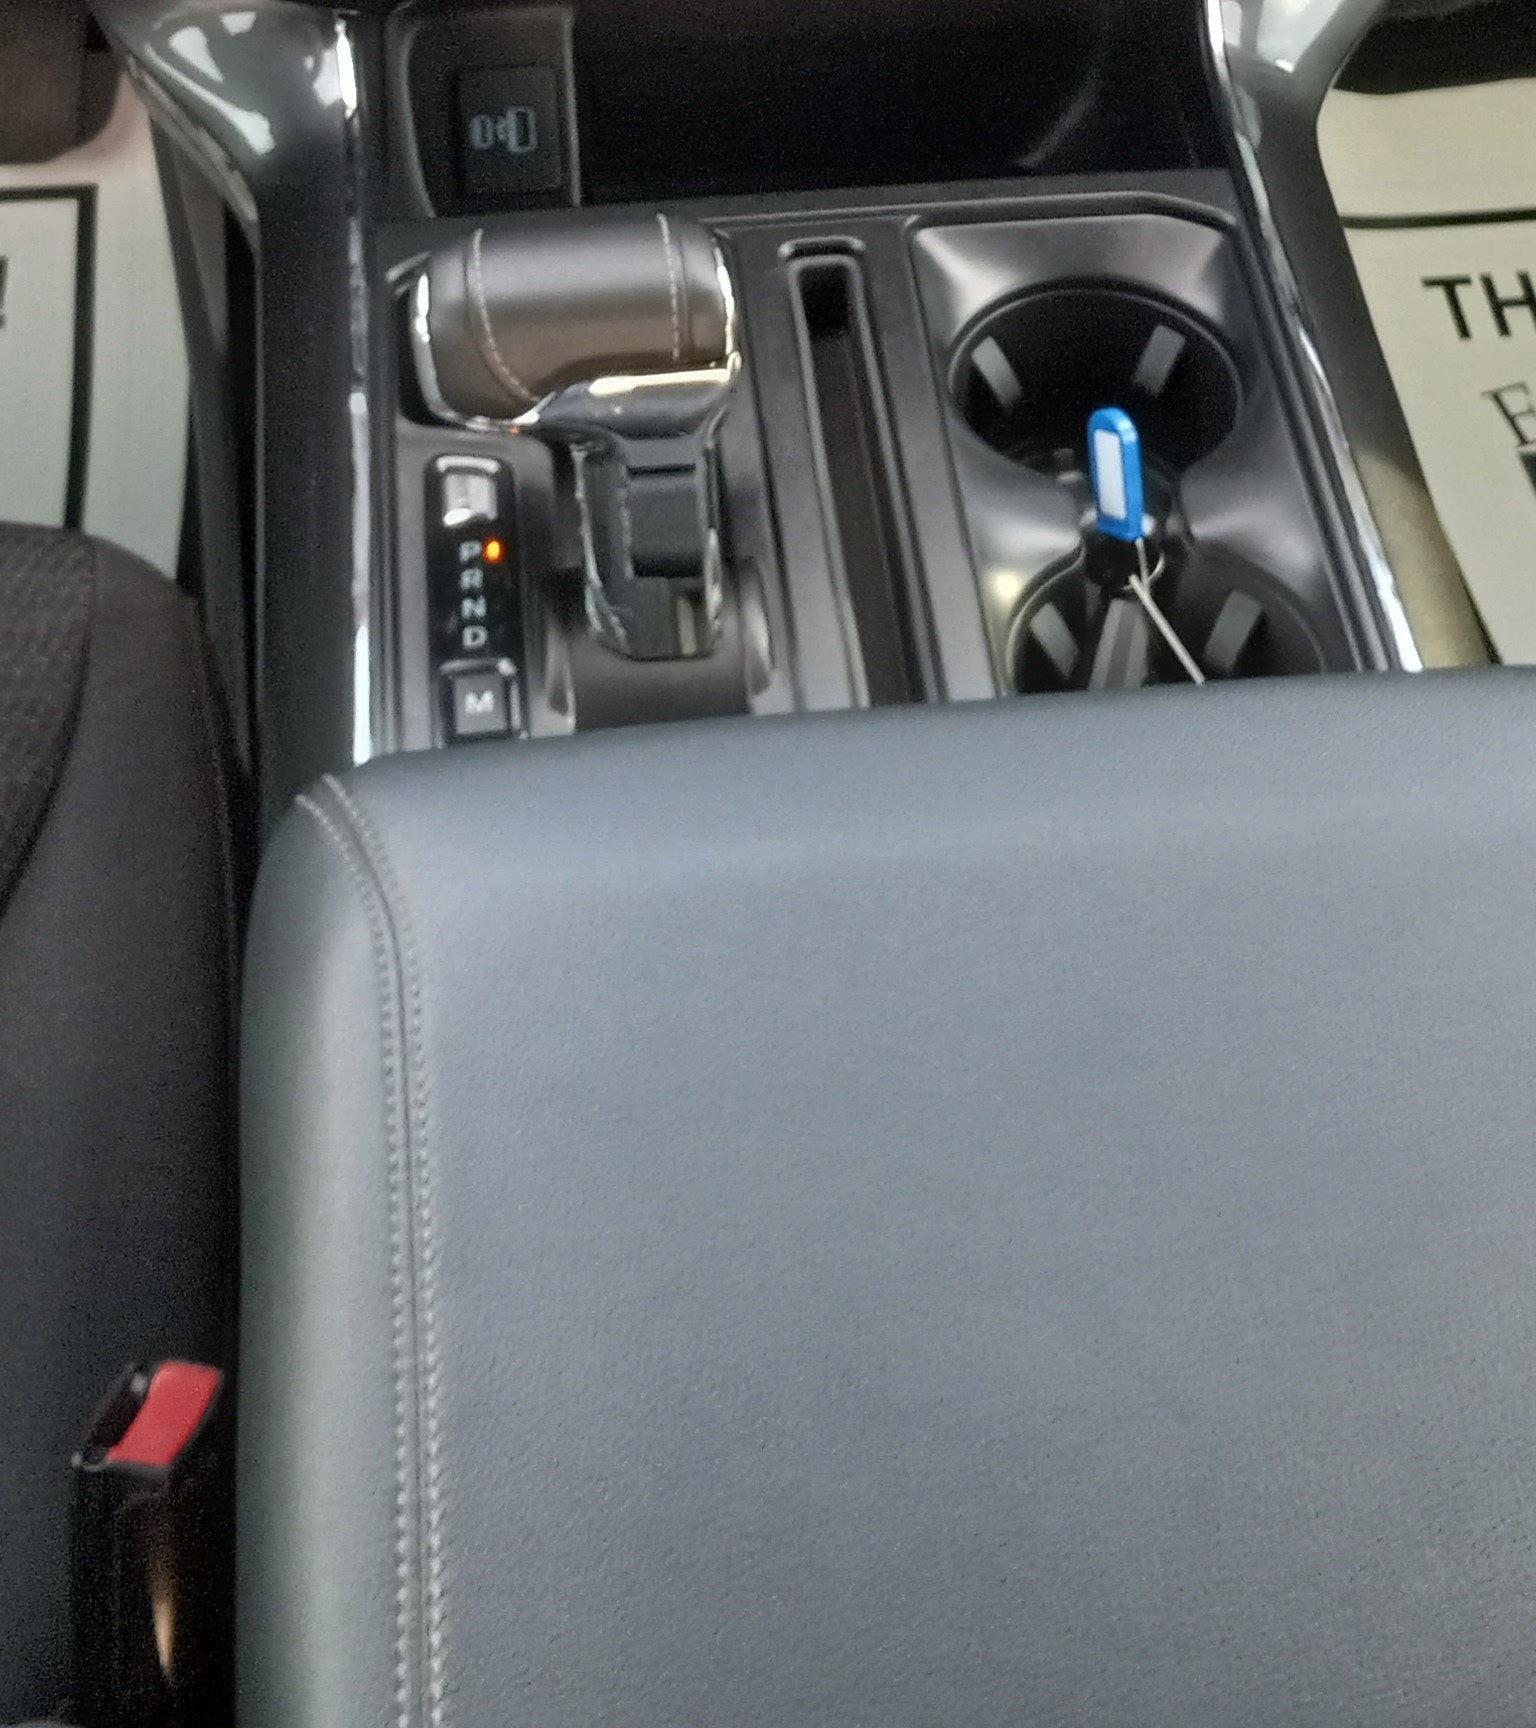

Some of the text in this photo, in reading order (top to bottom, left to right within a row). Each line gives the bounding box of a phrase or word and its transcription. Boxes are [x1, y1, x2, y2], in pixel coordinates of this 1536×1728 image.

[459, 540, 482, 562] P
[460, 567, 484, 590] R
[461, 594, 487, 619] N
[462, 624, 488, 650] D
[465, 689, 495, 714] M
